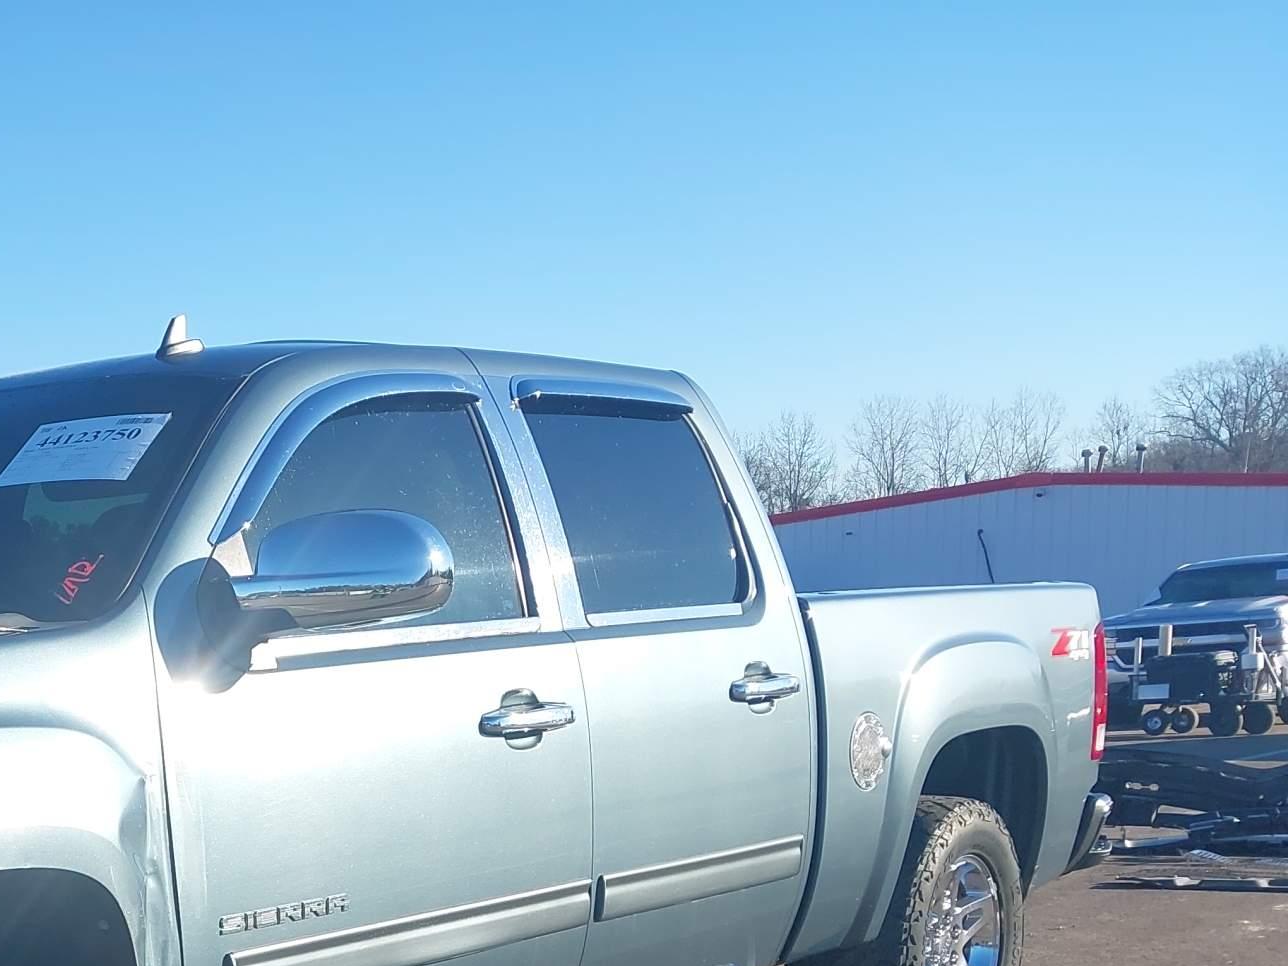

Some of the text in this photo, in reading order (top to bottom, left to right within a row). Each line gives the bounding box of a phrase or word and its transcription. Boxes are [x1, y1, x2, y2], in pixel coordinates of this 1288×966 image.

[36, 427, 142, 448] 44123750
[1050, 628, 1089, 656] Z71
[218, 893, 350, 936] SIERRA
